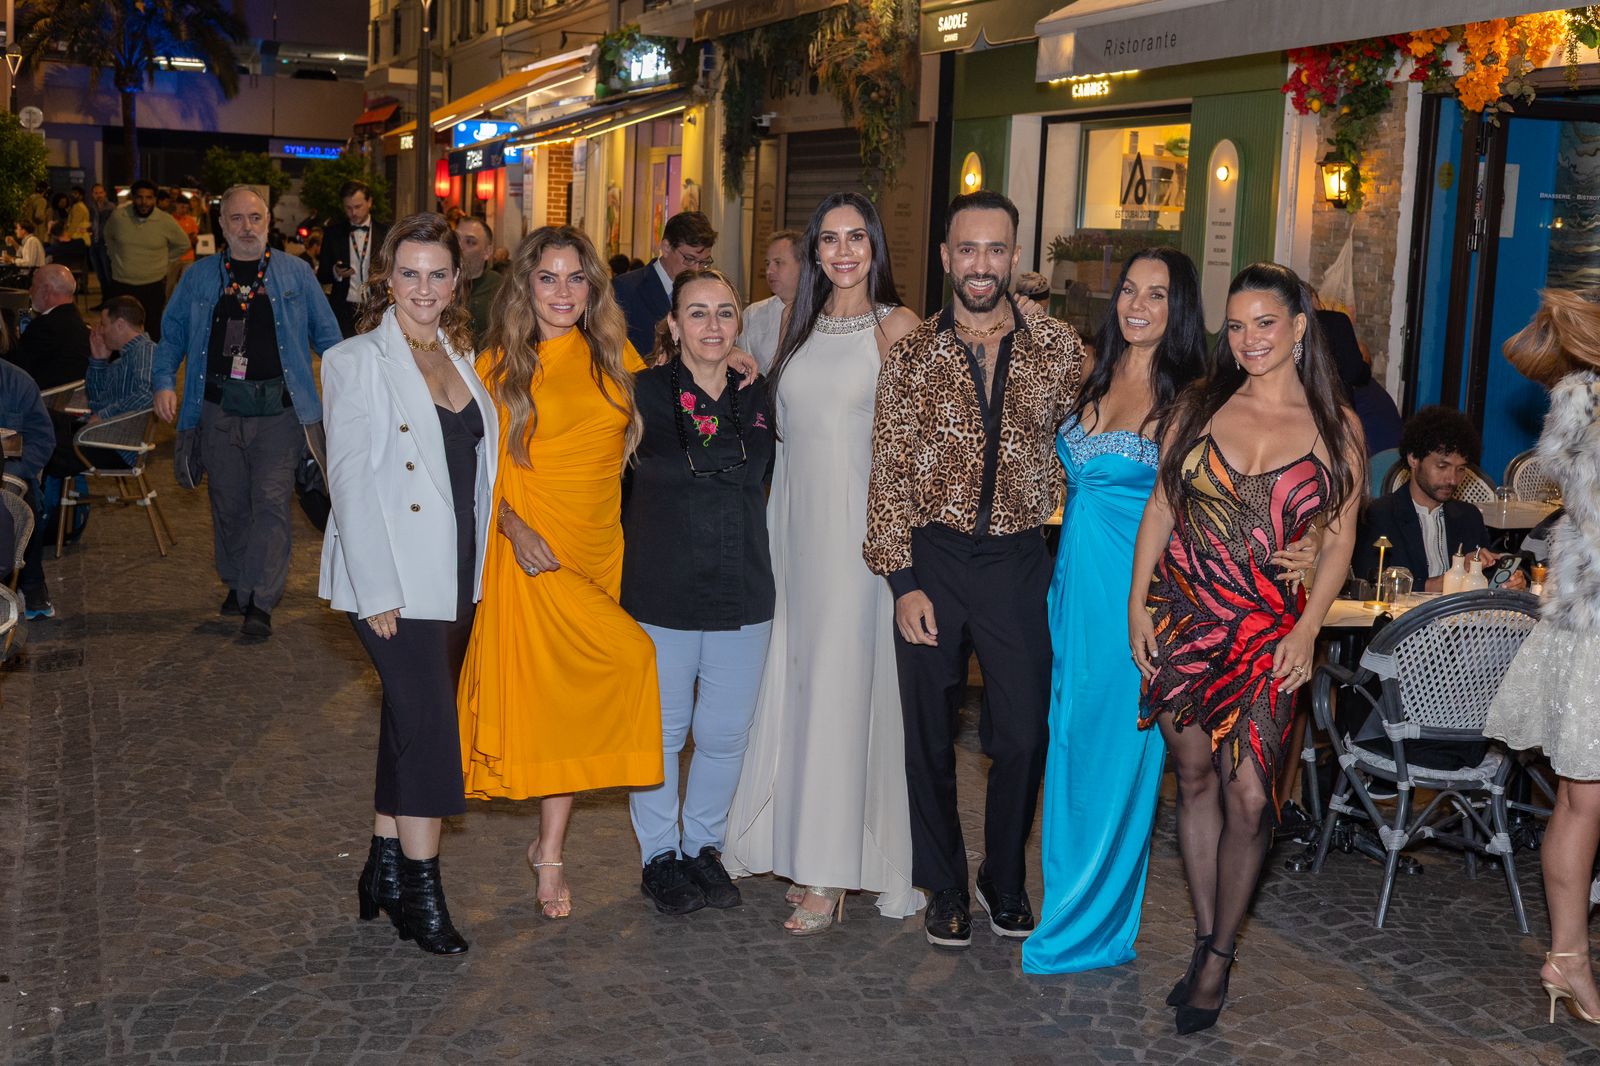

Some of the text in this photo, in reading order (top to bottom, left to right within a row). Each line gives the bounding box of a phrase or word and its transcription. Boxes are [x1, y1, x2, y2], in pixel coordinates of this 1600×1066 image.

[937, 12, 969, 32] SADDLE
[1104, 31, 1178, 57] Ristorante
[1071, 80, 1110, 99] CANNES
